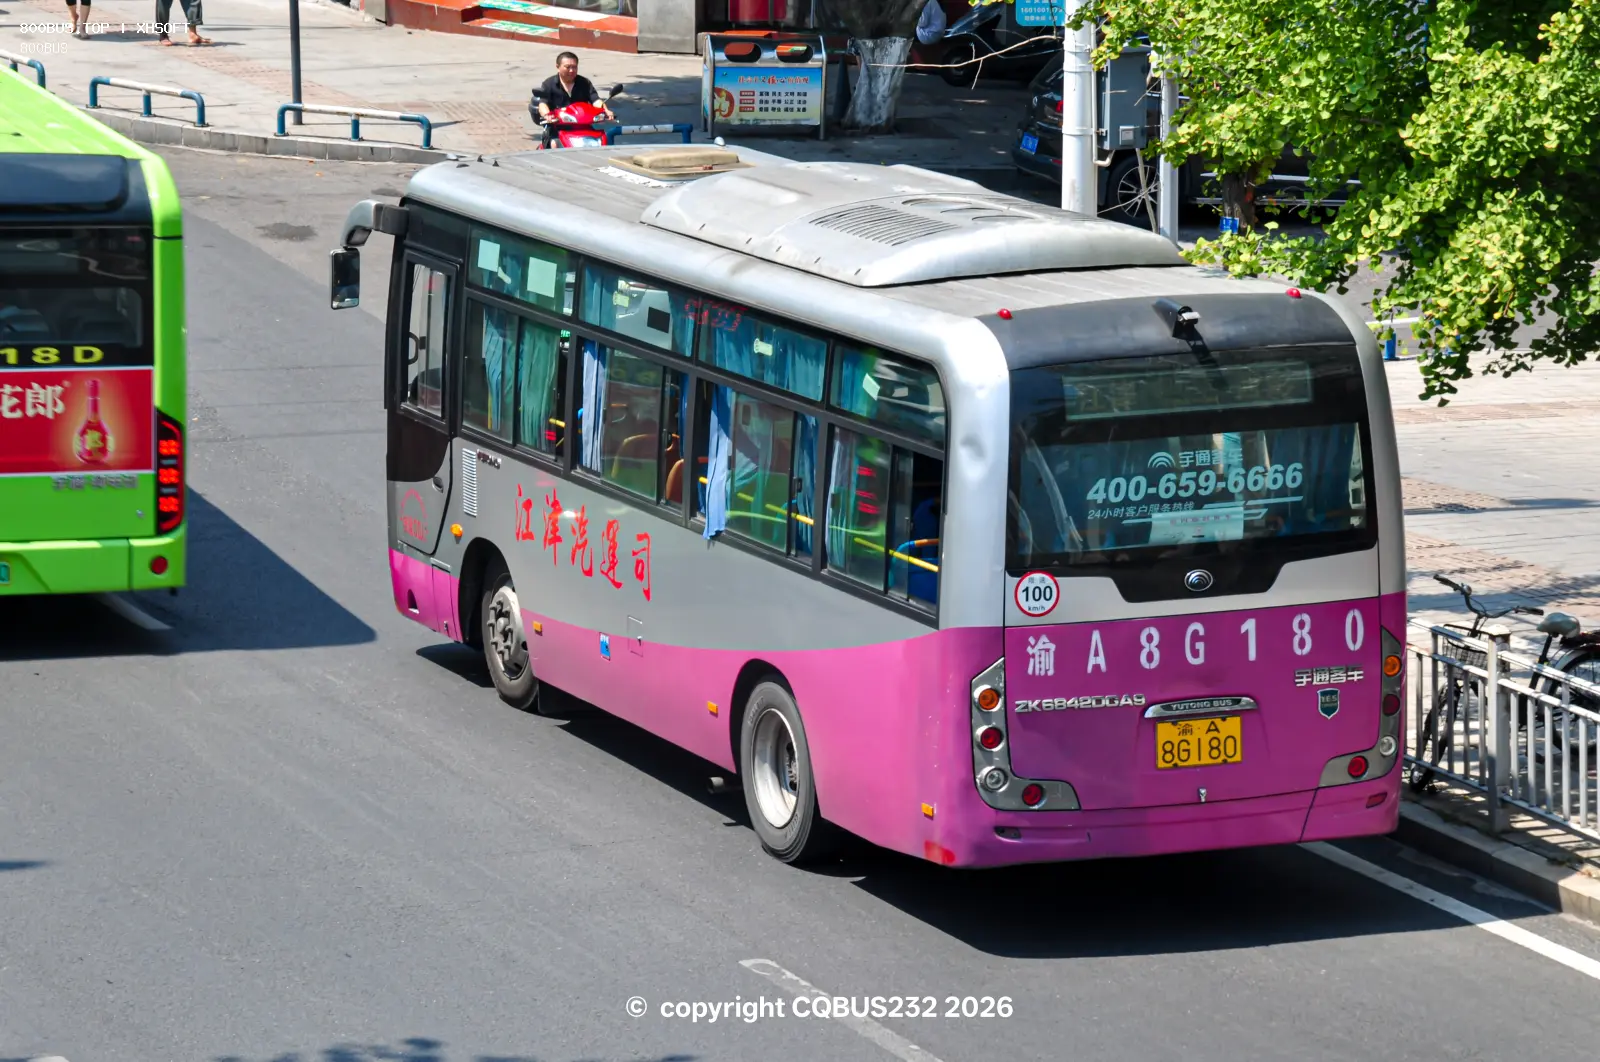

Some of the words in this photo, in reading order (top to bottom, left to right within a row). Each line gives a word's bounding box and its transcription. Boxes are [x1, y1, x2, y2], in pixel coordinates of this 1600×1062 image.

[1178, 449, 1244, 468] 宇通客车
[1086, 461, 1304, 504] 400-659-6666
[1087, 500, 1196, 521] 24小时客户服务热线
[1021, 585, 1053, 603] 100
[1294, 664, 1365, 687] 宇通客车
[1170, 700, 1212, 712] YUTONG
[1213, 698, 1234, 709] BUS
[1161, 734, 1238, 764] 8G180
